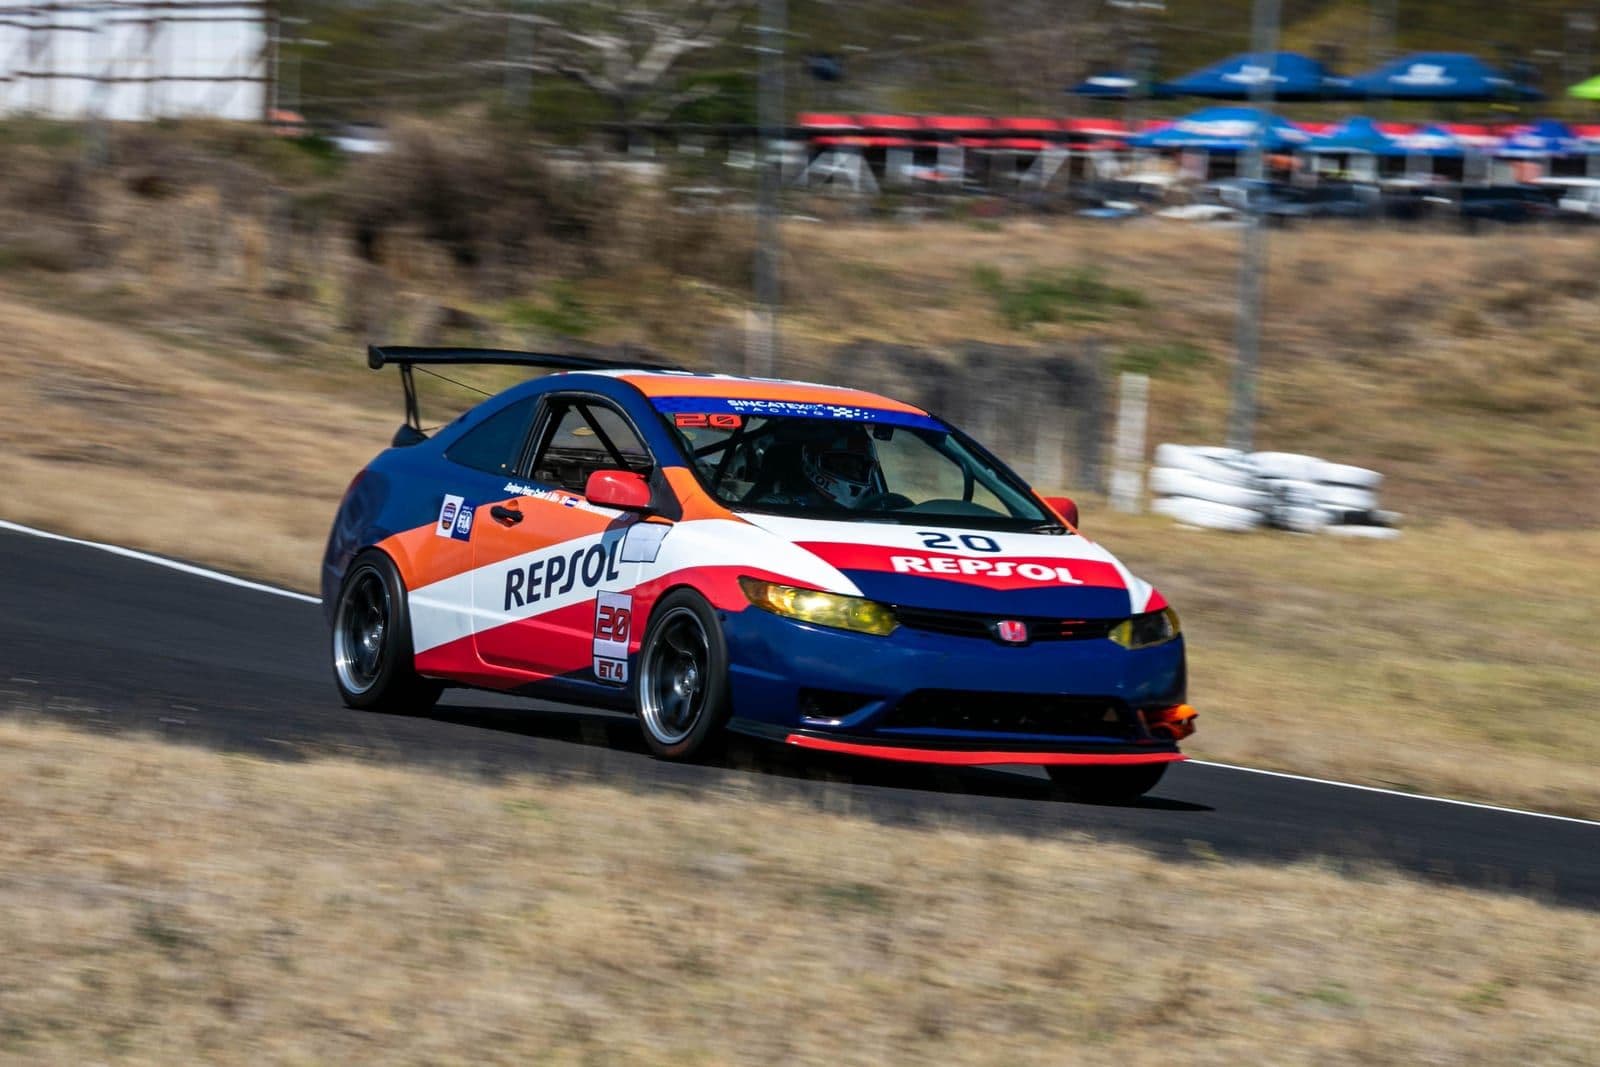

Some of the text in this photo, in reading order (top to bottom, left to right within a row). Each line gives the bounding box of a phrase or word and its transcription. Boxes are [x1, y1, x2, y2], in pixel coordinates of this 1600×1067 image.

[674, 413, 742, 429] 20
[734, 407, 824, 416] RACING
[916, 531, 1002, 552] 20
[504, 540, 620, 611] REPSOL
[889, 555, 1083, 585] REPSOL
[596, 605, 631, 642] 20
